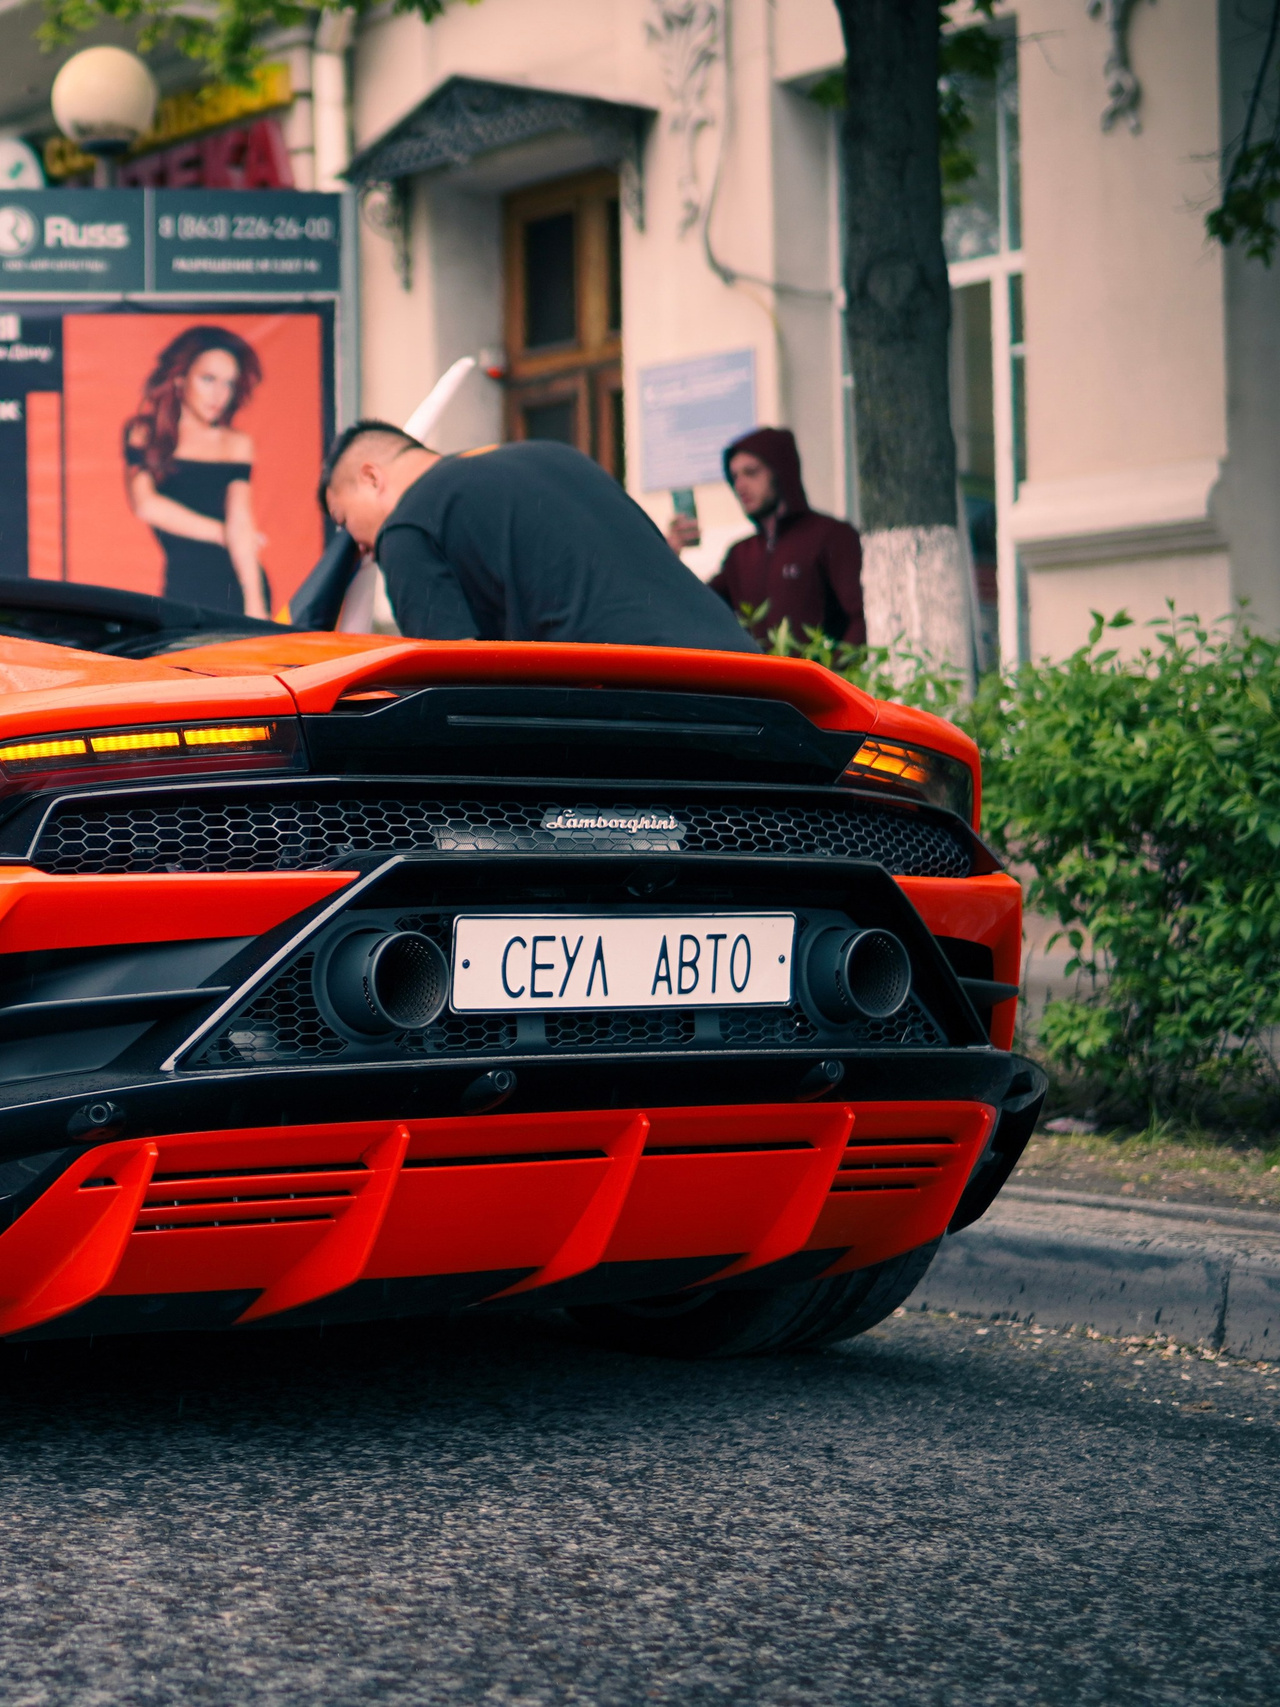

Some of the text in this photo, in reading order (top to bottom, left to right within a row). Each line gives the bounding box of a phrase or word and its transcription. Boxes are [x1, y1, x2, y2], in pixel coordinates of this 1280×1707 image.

[44, 216, 130, 248] Russ
[178, 212, 230, 241] (863)
[232, 215, 333, 240] 226-26-00
[546, 809, 677, 834] Lamborghini
[501, 933, 752, 999] СЕУЛ АВТО
